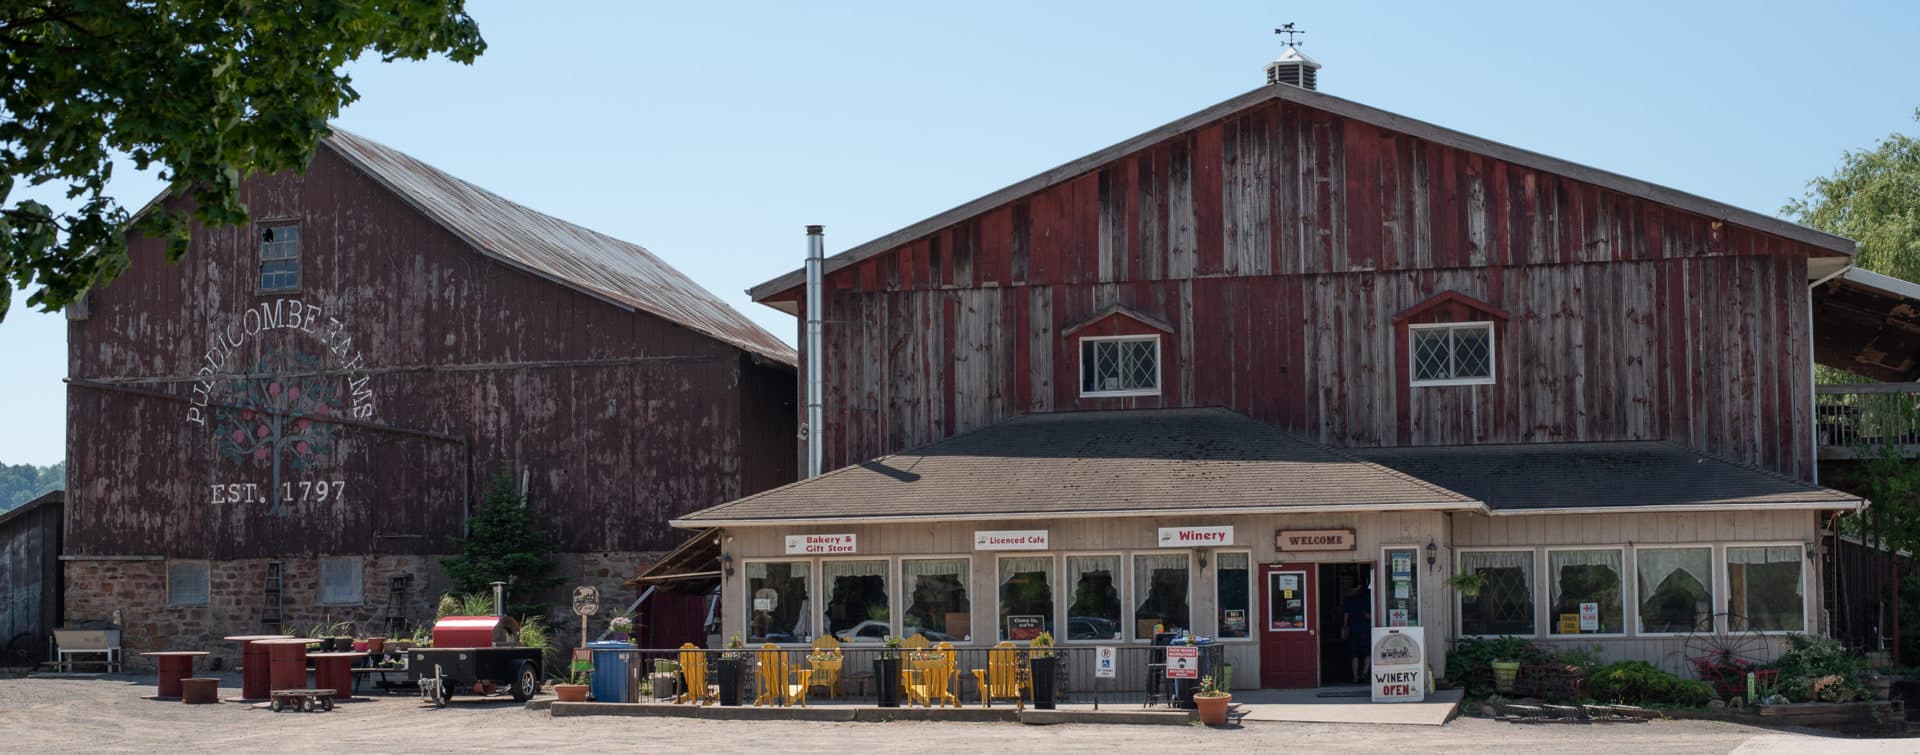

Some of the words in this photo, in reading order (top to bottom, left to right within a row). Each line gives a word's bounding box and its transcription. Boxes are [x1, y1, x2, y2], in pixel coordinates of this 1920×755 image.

[186, 298, 322, 426] PUDDICOMBE
[322, 317, 373, 420] FARMS
[211, 483, 267, 505] EST.
[283, 481, 346, 503] 1797
[806, 536, 840, 544] Bakery
[989, 536, 1025, 544] Licenced
[1027, 536, 1045, 544] Cafe
[1178, 530, 1226, 542] Winery
[1289, 535, 1343, 545] WELCOME
[828, 544, 853, 552] Store
[1375, 672, 1418, 683] WINERY
[1383, 684, 1410, 696] OPEN
